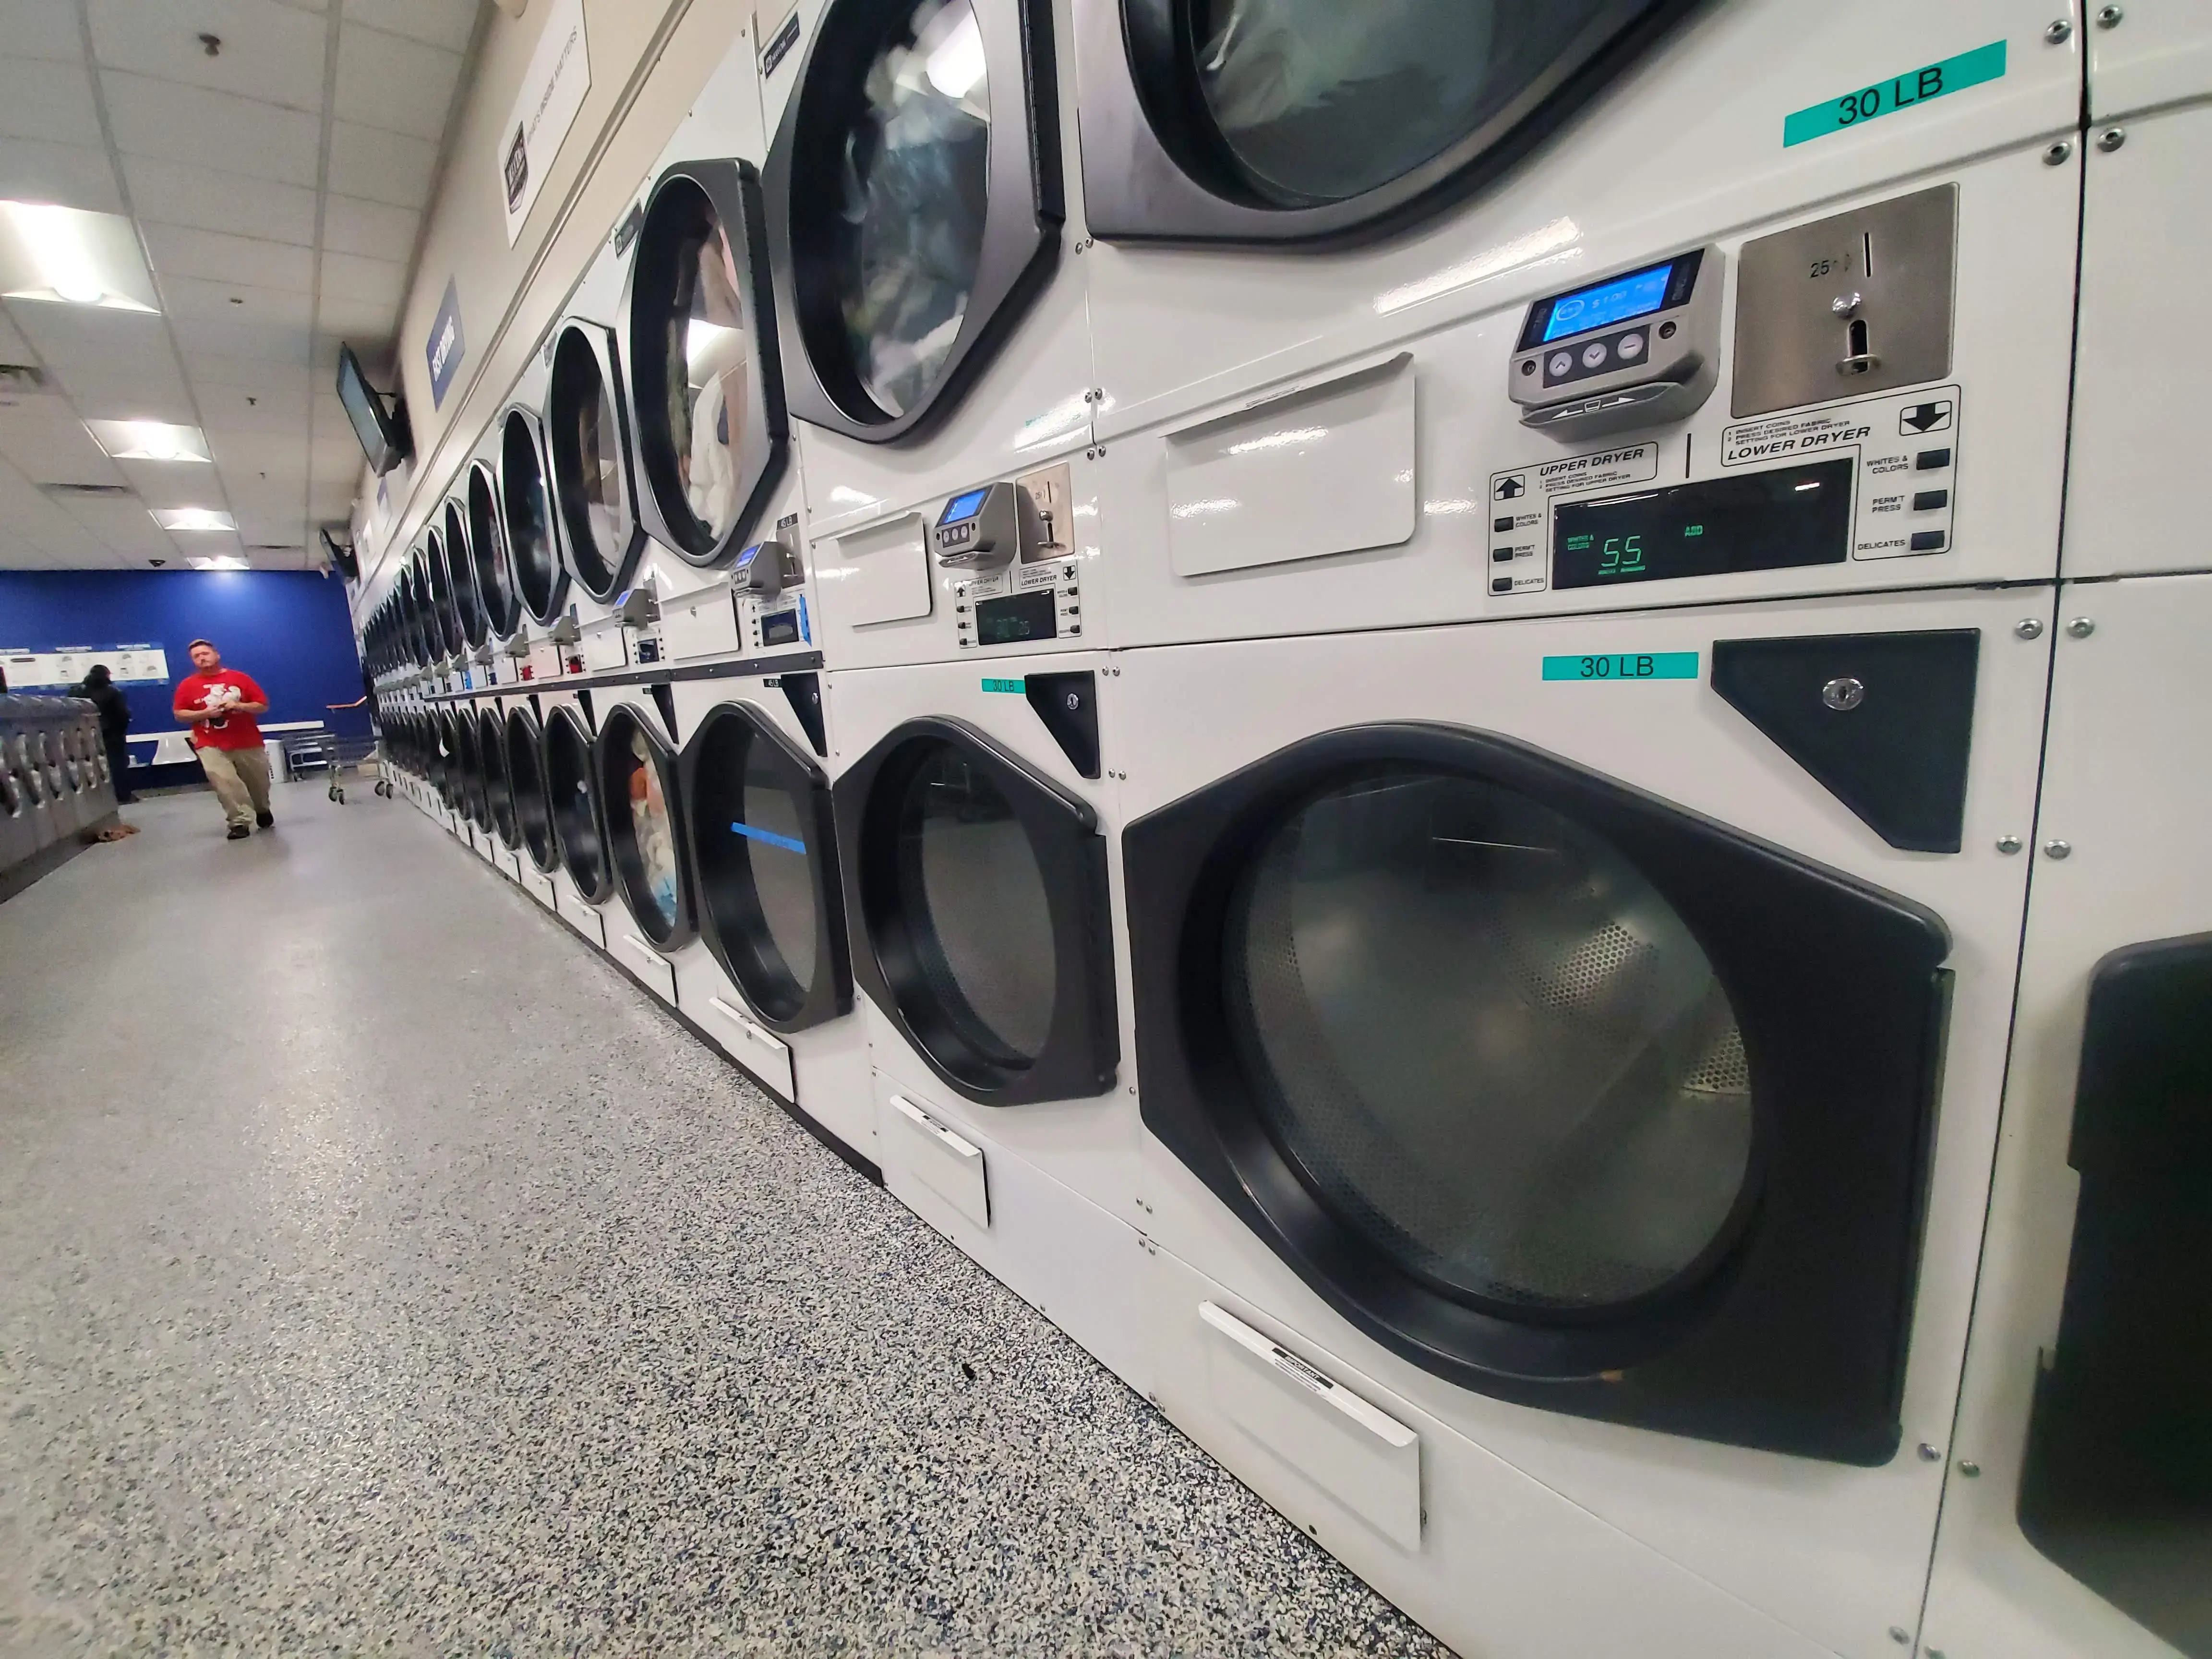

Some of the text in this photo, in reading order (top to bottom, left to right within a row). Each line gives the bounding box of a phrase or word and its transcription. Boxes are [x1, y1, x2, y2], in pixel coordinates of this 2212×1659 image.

[1839, 67, 1943, 125] 30 LB
[1736, 425, 1763, 434] INSERT
[1736, 436, 1768, 445] SETTING
[1790, 427, 1818, 435] LOWER
[1821, 421, 1850, 430] DRYER
[1764, 425, 1798, 434] DESIRED
[1801, 418, 1831, 427] FABRIC
[1728, 426, 1871, 460] LOWER DRYER
[1540, 448, 1644, 476] UPPER DRYER
[1867, 457, 1899, 467] WHITES
[1873, 464, 1908, 474] COLORS
[1872, 505, 1901, 513] PRESS
[1685, 525, 1703, 537] ADD
[1601, 535, 1641, 567] 55
[1858, 540, 1906, 550] DELICATES
[1040, 575, 1057, 583] DRYER
[1580, 656, 1654, 677] 30 LB
[993, 680, 1014, 691] 30 LB
[1285, 1356, 1320, 1379] IMPORTANT
